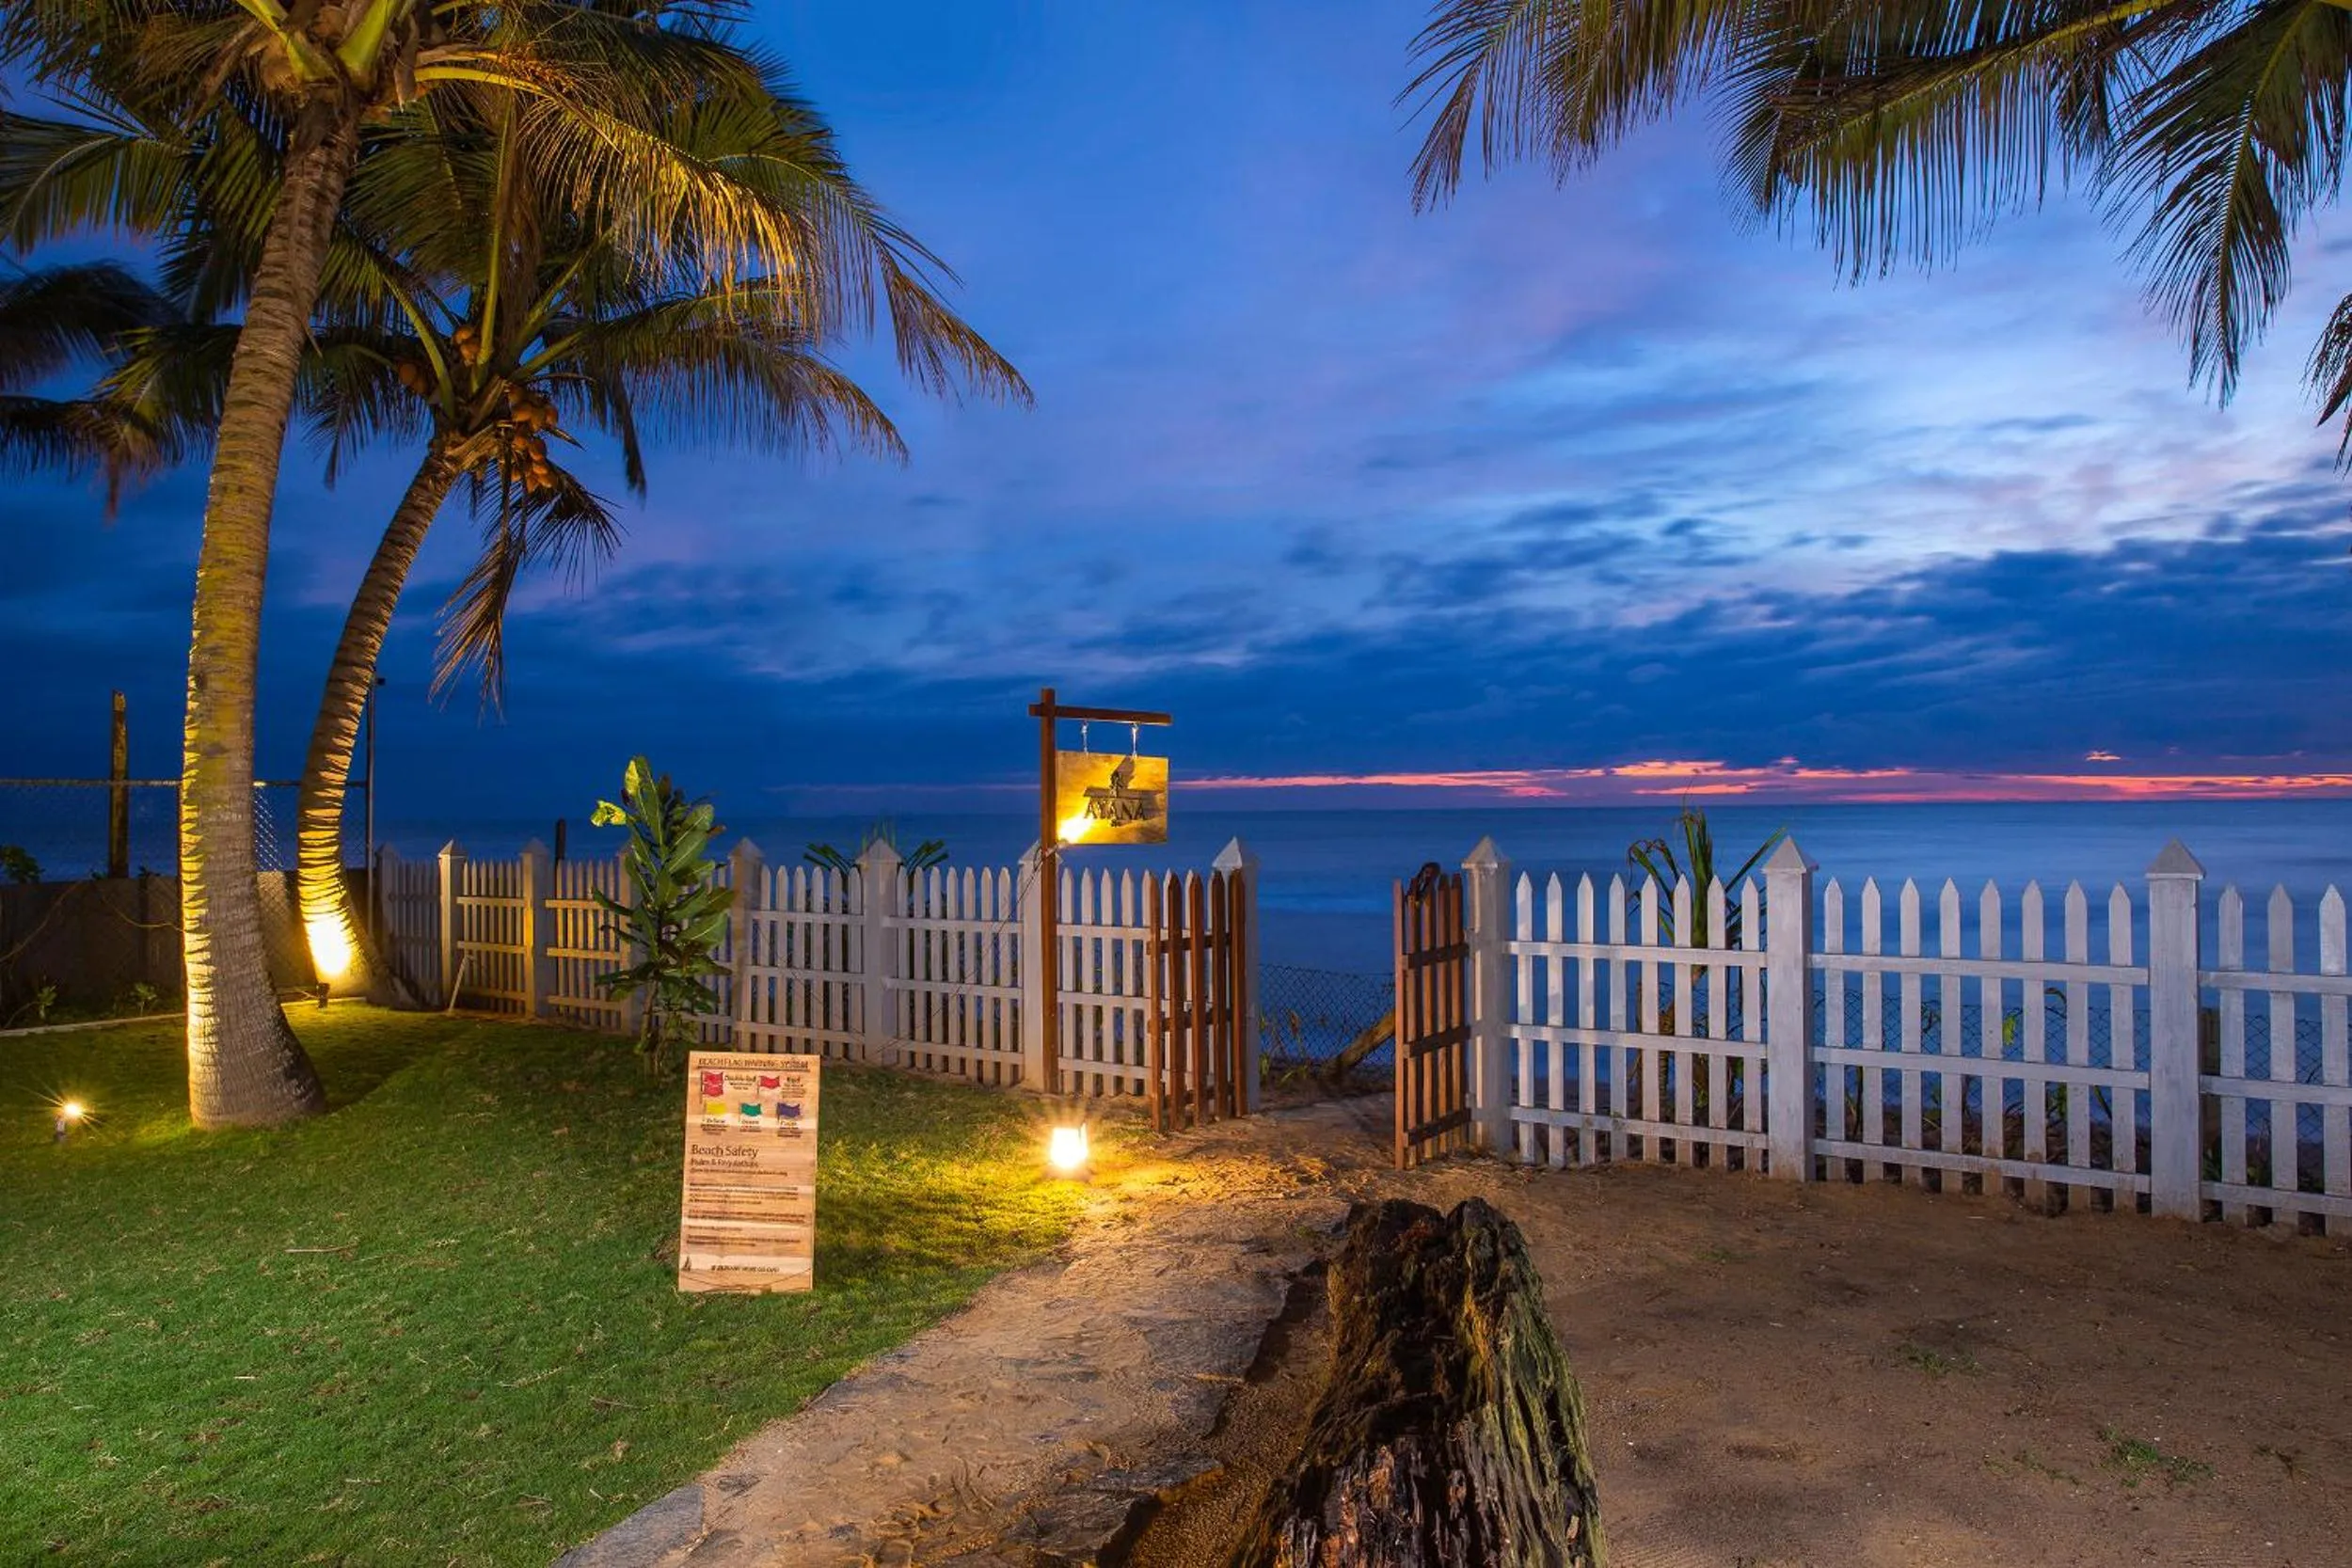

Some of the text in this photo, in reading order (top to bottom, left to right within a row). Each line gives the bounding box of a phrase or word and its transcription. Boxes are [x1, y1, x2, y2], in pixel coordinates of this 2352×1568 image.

[1084, 798, 1148, 820] AYANA
[691, 1144, 759, 1159] Beach Safety
